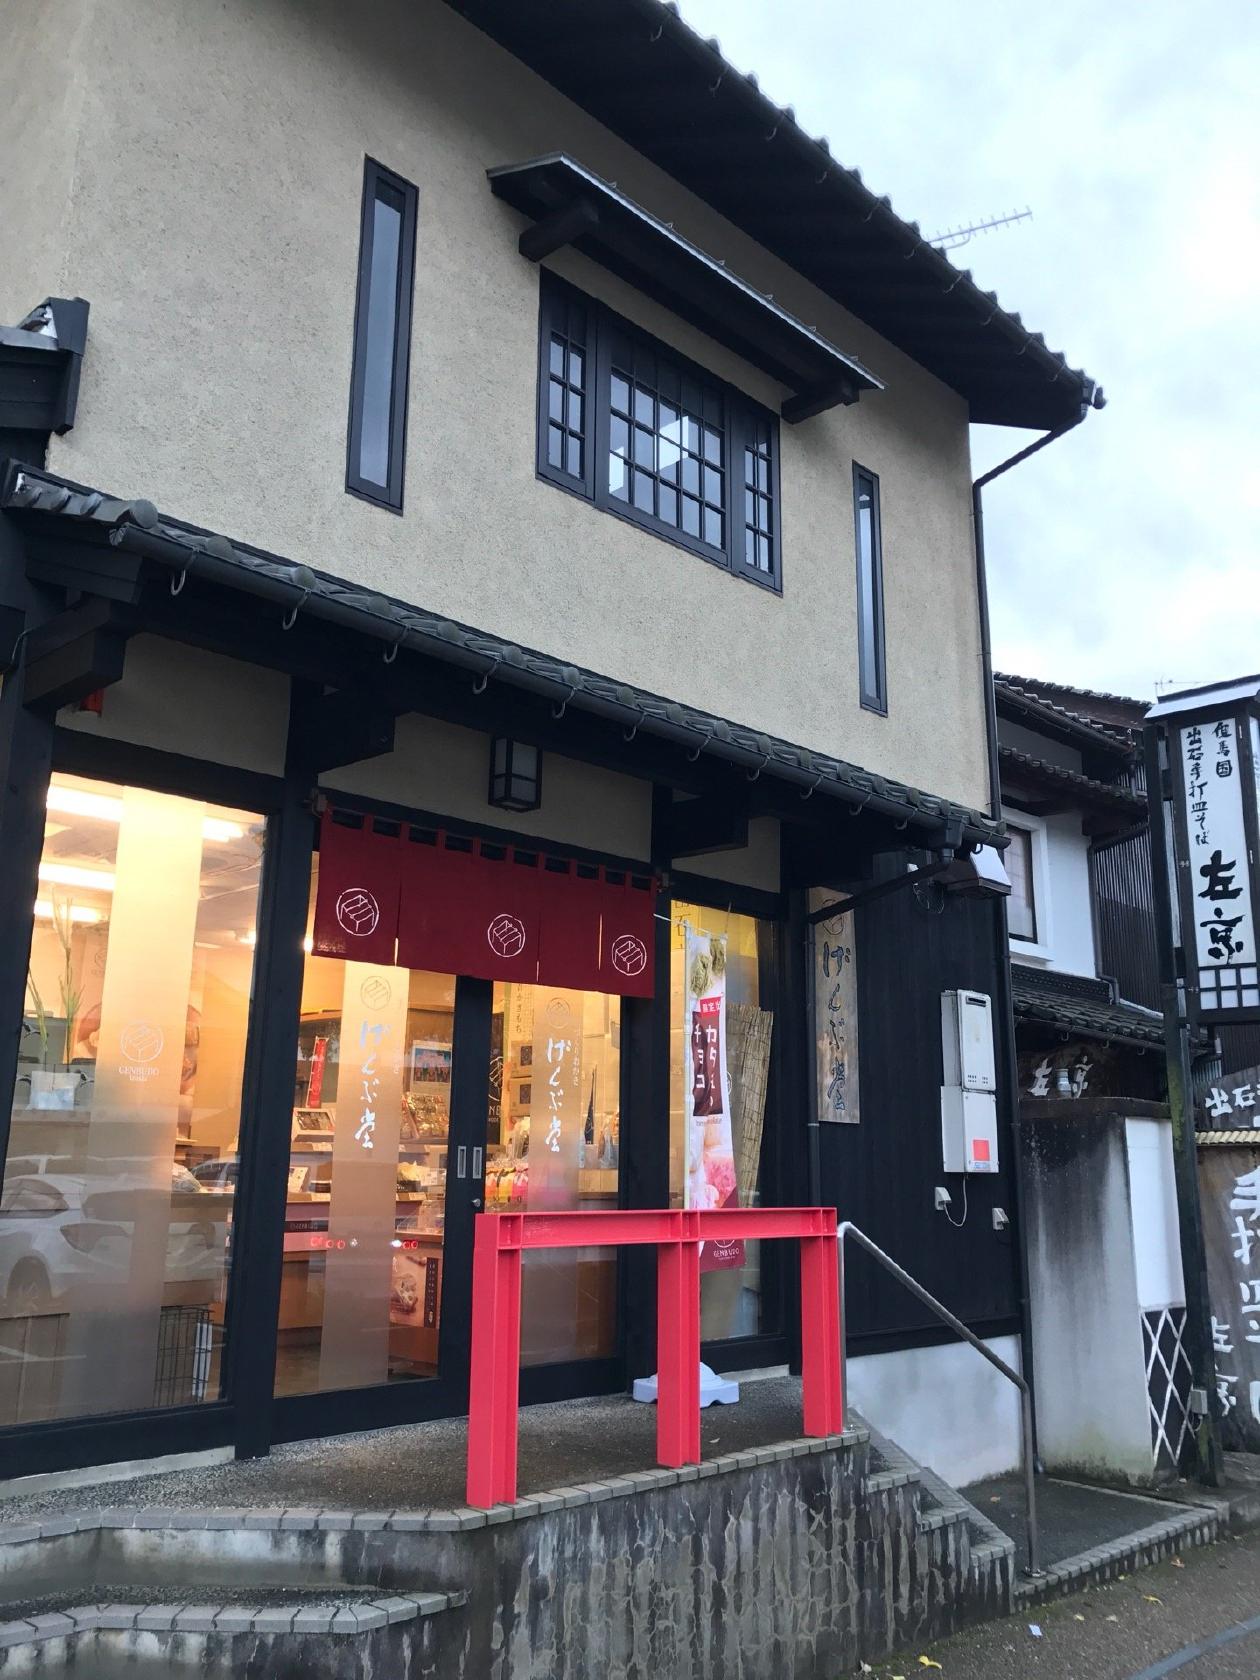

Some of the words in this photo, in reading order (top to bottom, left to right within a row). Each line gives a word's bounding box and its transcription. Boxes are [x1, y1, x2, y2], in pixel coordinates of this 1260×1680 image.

[1185, 727, 1209, 846] 出石手打皿そば
[694, 1023, 706, 1089] チョコ
